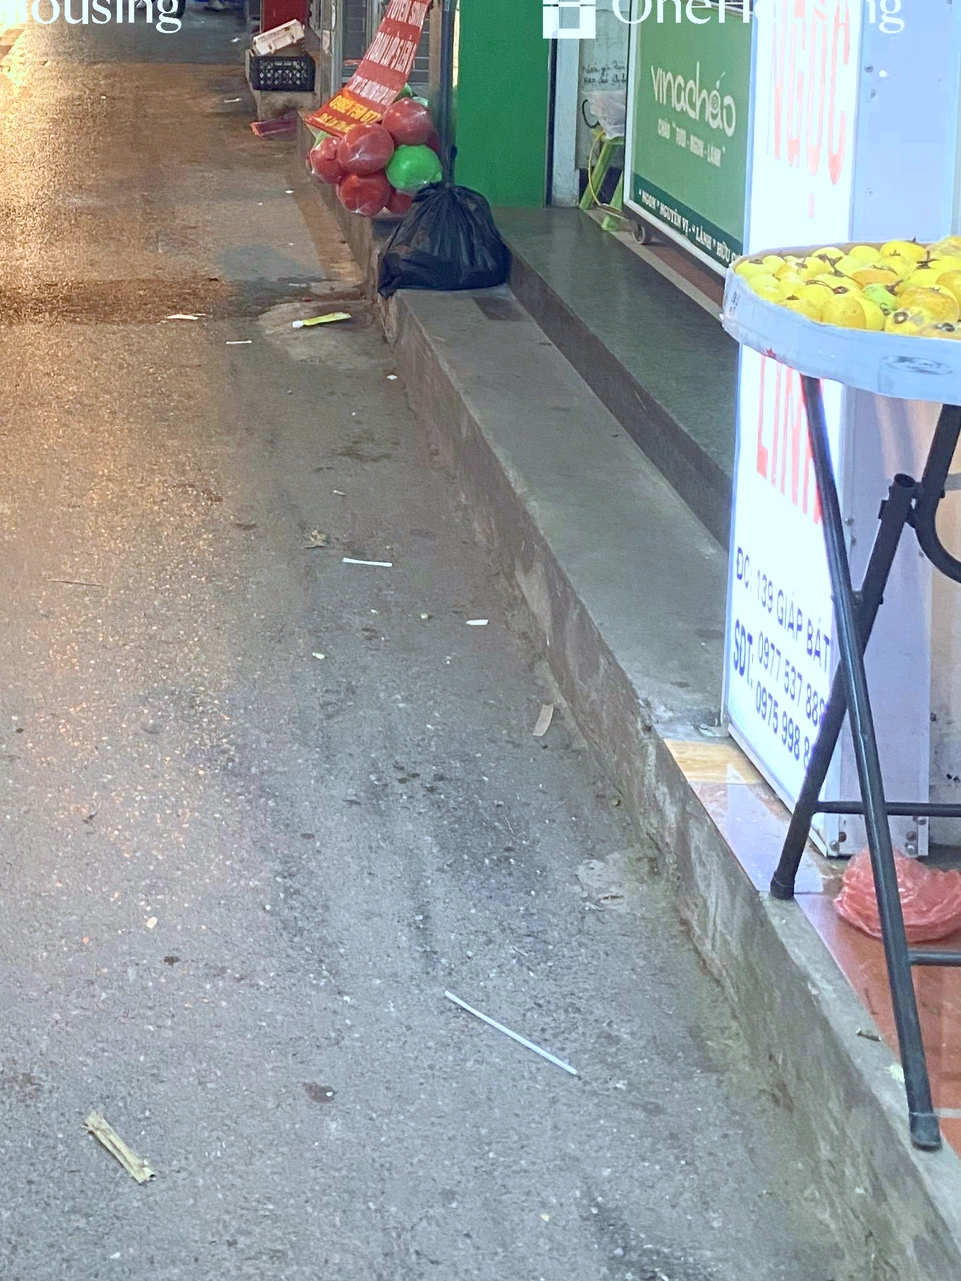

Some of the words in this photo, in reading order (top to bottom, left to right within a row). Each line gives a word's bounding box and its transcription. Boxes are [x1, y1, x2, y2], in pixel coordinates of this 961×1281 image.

[651, 60, 737, 137] vinacháo
[757, 569, 774, 614] 139
[777, 589, 803, 642] GIÁP
[806, 616, 830, 673] BÁT
[758, 631, 781, 682] 0977
[784, 658, 803, 707] 537
[756, 681, 779, 735] 0975
[782, 710, 801, 761] 998
